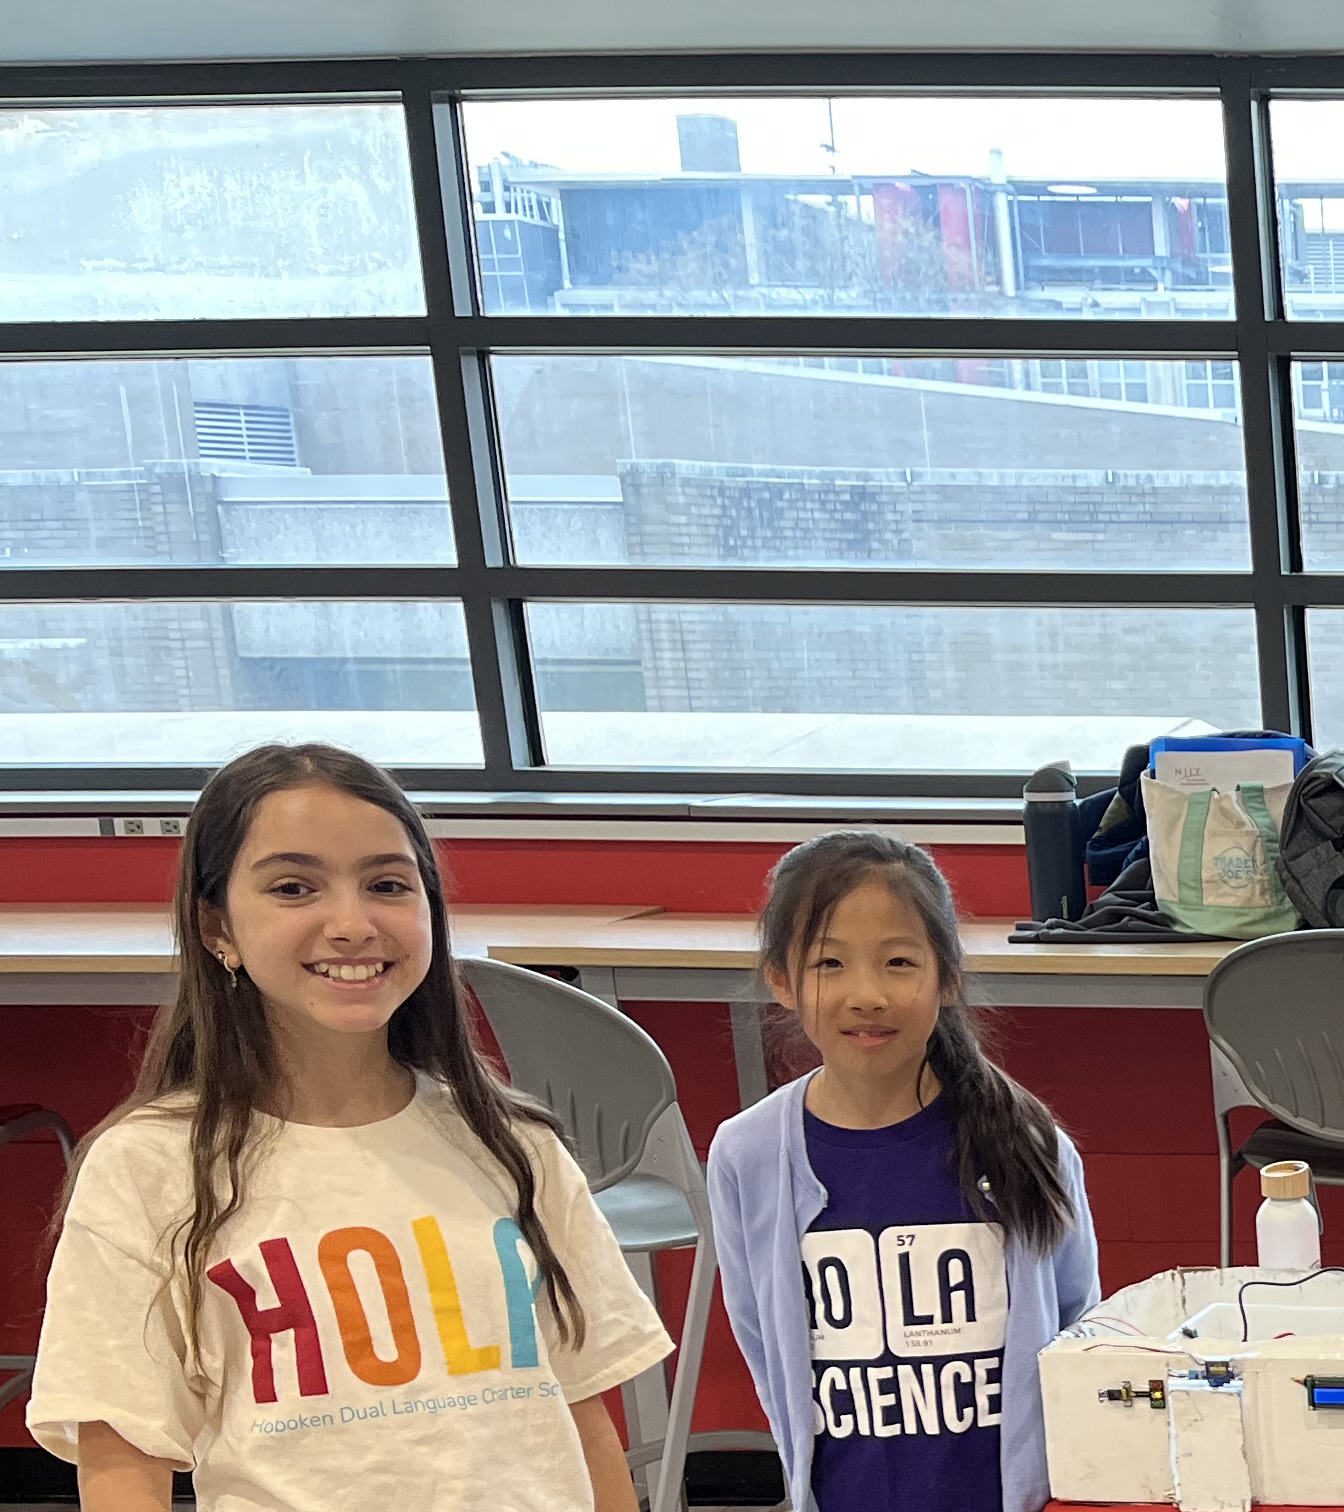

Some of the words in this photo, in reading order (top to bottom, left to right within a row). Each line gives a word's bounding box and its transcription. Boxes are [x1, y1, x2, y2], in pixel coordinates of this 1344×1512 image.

[896, 1234, 916, 1247] 57
[898, 1248, 977, 1327] LA
[903, 1327, 962, 1338] LANTHANUM
[251, 1411, 335, 1435] Hoboken
[340, 1402, 388, 1424] Dual
[392, 1393, 479, 1420] Language
